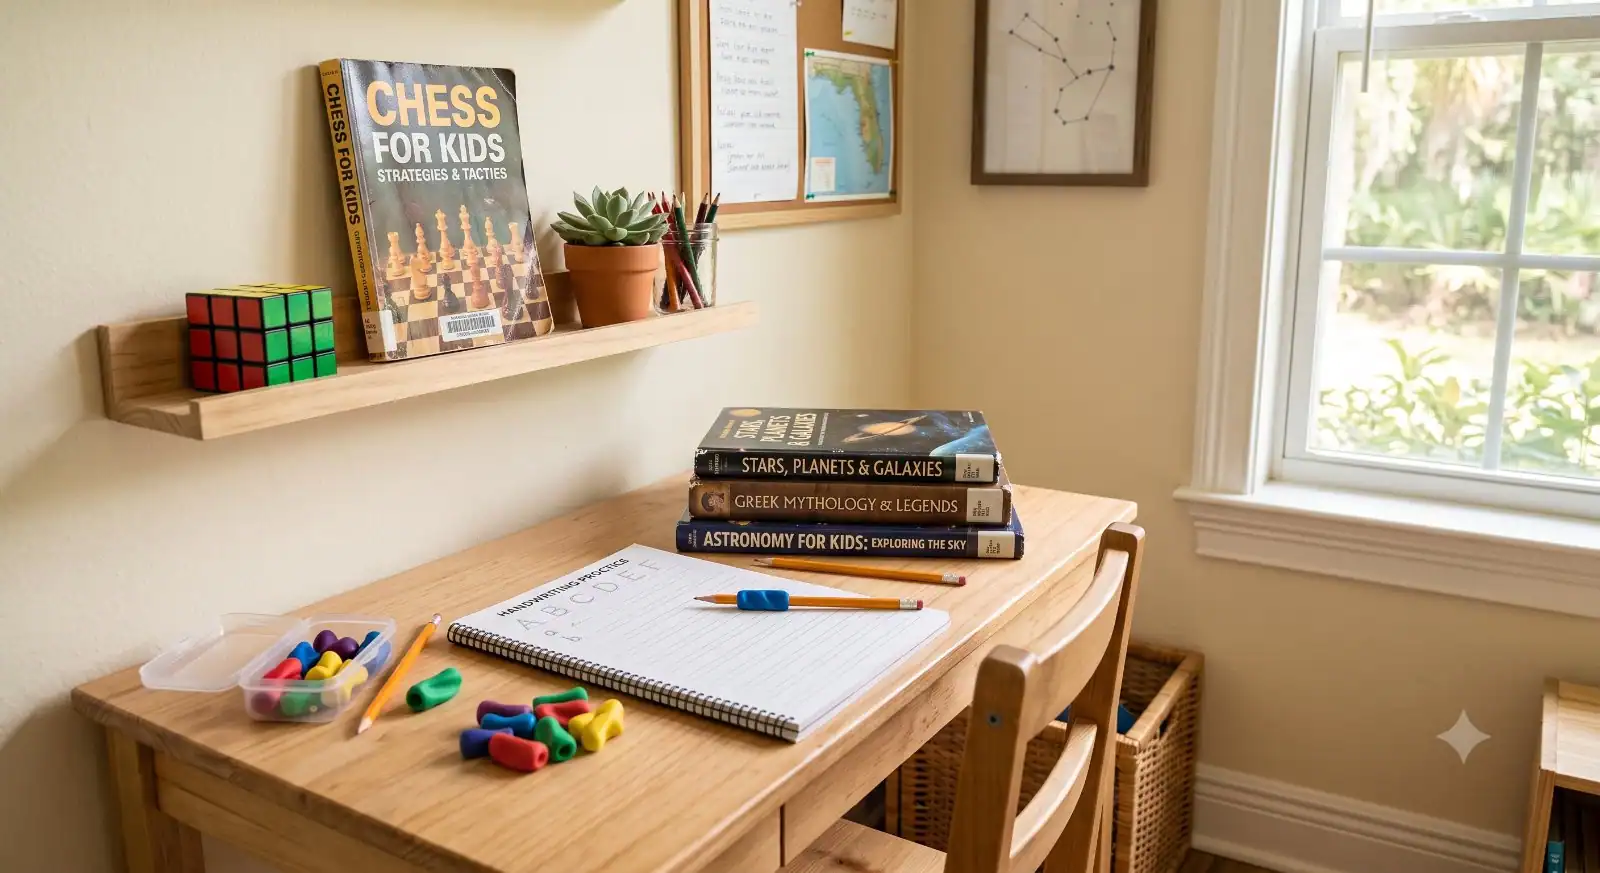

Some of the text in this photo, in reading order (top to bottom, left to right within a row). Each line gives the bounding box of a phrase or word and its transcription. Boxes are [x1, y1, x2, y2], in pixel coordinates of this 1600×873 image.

[327, 83, 348, 144] CHESS
[366, 80, 501, 129] CHESS
[337, 147, 354, 181] FOR
[372, 131, 506, 164] FOR KIDS
[377, 168, 449, 183] STRATEGIES
[451, 168, 461, 181] &
[343, 184, 361, 225] KIDS
[760, 415, 791, 442] PLANETS
[788, 412, 817, 440] GALAXIES
[742, 457, 788, 477] STARS,
[793, 458, 855, 475] PLANETS
[858, 460, 870, 476] &
[873, 460, 943, 477] GALAXIES
[734, 495, 780, 509] GREEK
[784, 496, 877, 511] MYTHOLOGY
[880, 500, 892, 511] &
[896, 499, 958, 513] LEGENDS
[703, 531, 795, 549] ASTRONOMY
[798, 533, 826, 550] FOR
[829, 534, 868, 551] KIDS:
[871, 537, 925, 549] EXPLORING
[927, 539, 947, 550] THE
[947, 540, 967, 551] SKY
[496, 580, 580, 618] HANDWRITING
[516, 559, 662, 631] A B C D E F
